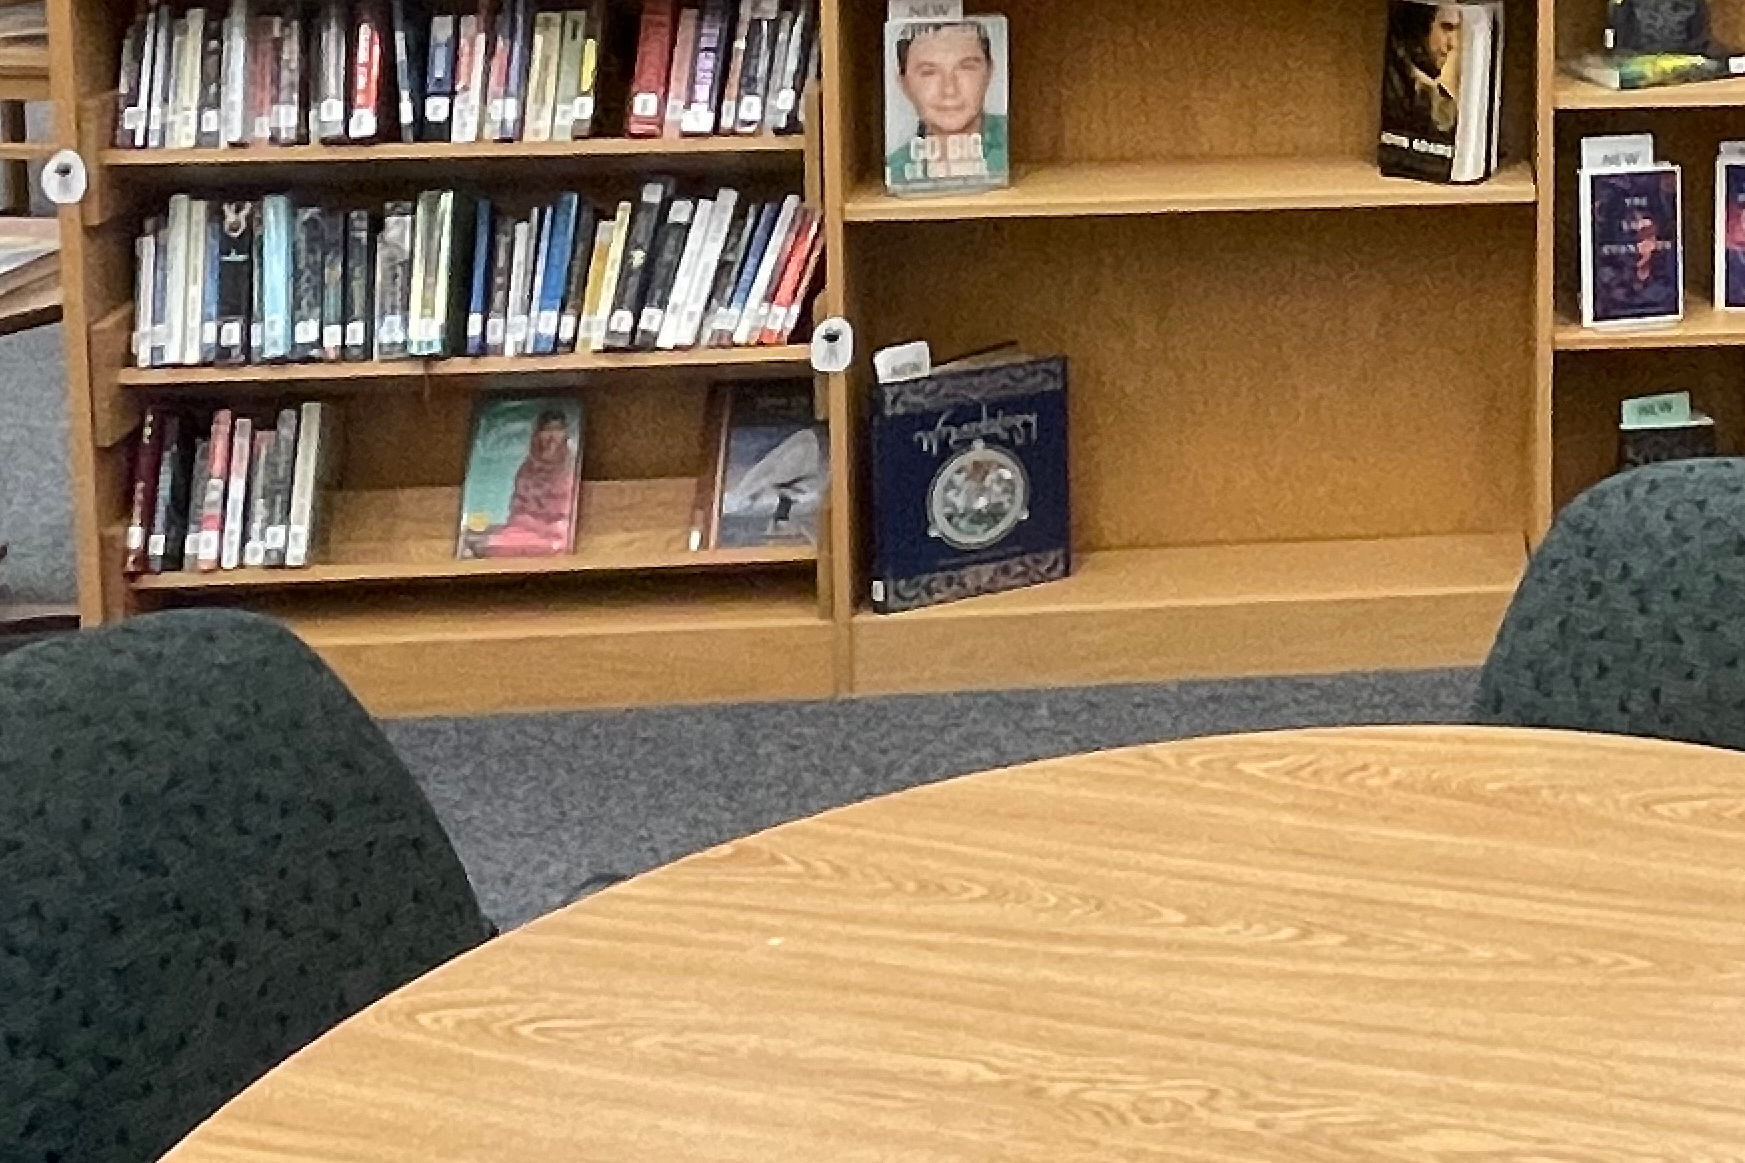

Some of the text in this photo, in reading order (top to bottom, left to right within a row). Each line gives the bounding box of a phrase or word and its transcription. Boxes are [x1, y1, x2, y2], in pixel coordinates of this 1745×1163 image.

[909, 4, 949, 16] NEW
[947, 134, 984, 159] BIG
[1602, 153, 1640, 165] NEW
